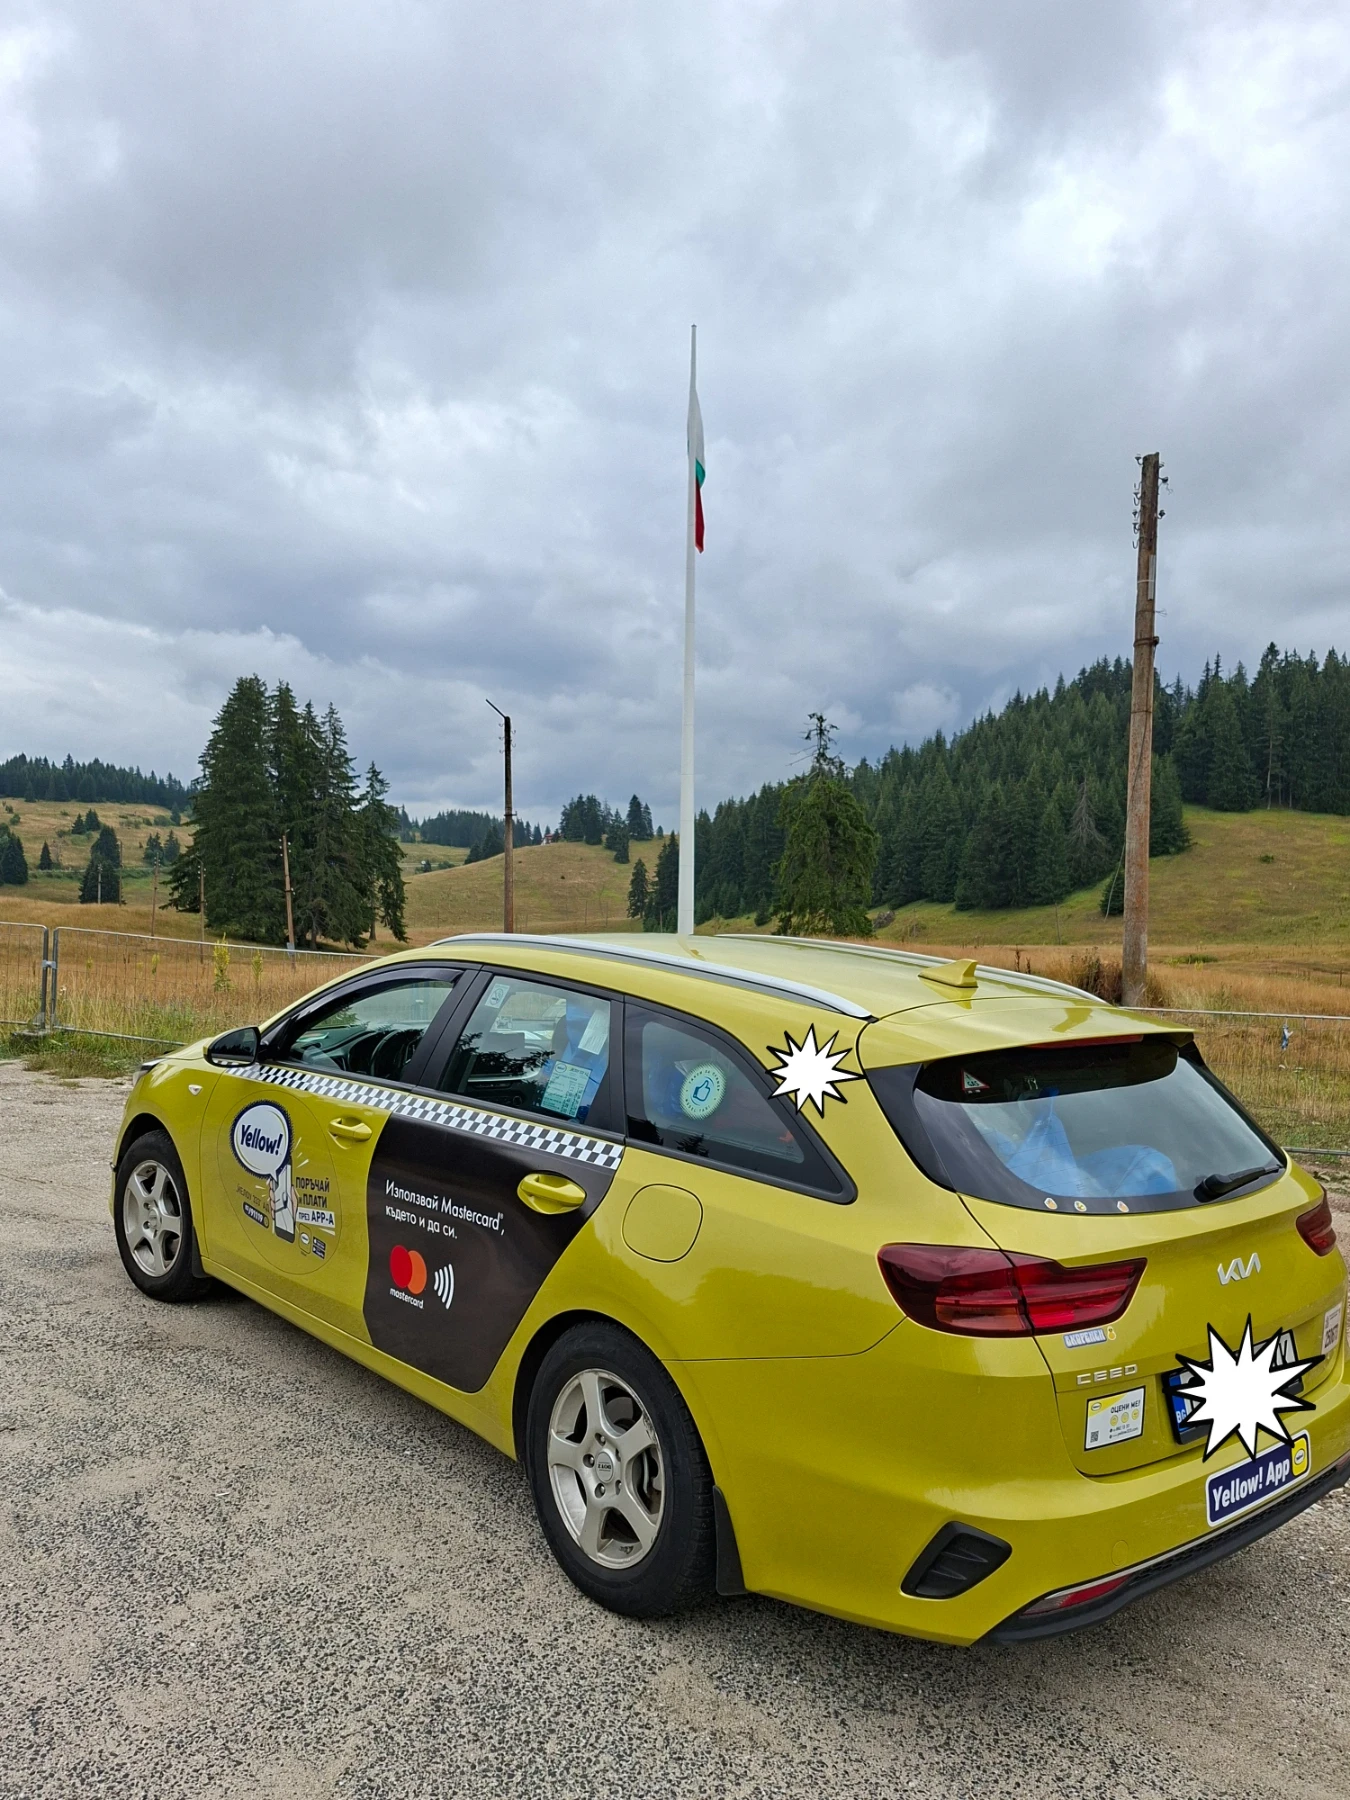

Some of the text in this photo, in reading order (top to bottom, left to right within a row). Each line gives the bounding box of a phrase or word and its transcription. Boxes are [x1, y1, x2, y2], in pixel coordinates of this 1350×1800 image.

[240, 1124, 283, 1156] Yellow!
[295, 1177, 330, 1193] ПОРЪЧАЙ
[385, 1179, 439, 1211] Използвай
[303, 1193, 328, 1208] ПЛАТИ
[311, 1210, 334, 1225] APP-A
[385, 1205, 457, 1239] където и да си.
[389, 1287, 424, 1309] mastercard
[1077, 1364, 1137, 1385] CEED
[1110, 1402, 1130, 1414] ОЦЕНИ
[1212, 1459, 1290, 1511] Yellow! App
